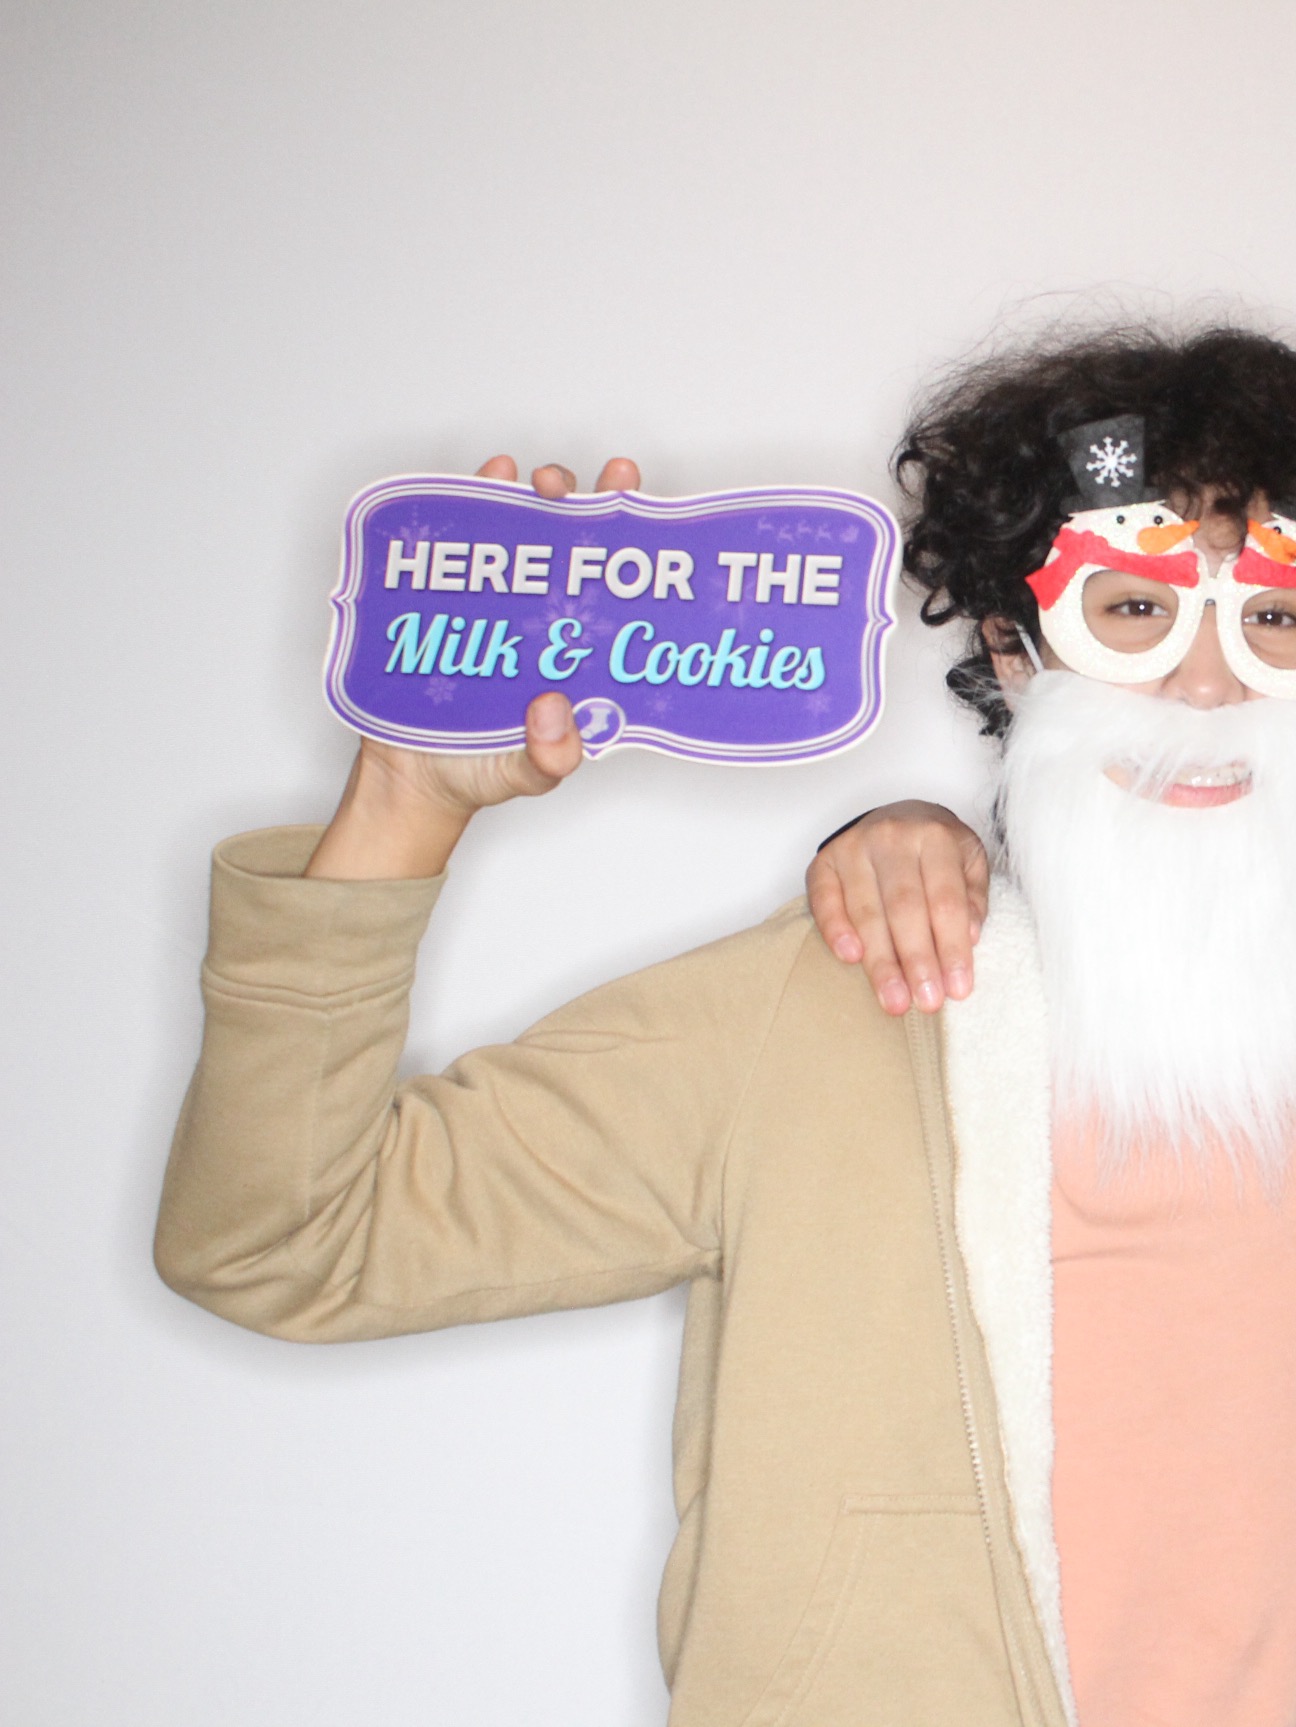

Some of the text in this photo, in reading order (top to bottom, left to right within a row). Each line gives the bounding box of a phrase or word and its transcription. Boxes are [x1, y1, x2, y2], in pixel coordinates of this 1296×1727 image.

[384, 540, 843, 606] HERE FOR THE
[384, 611, 826, 691] Milk & Cookies
